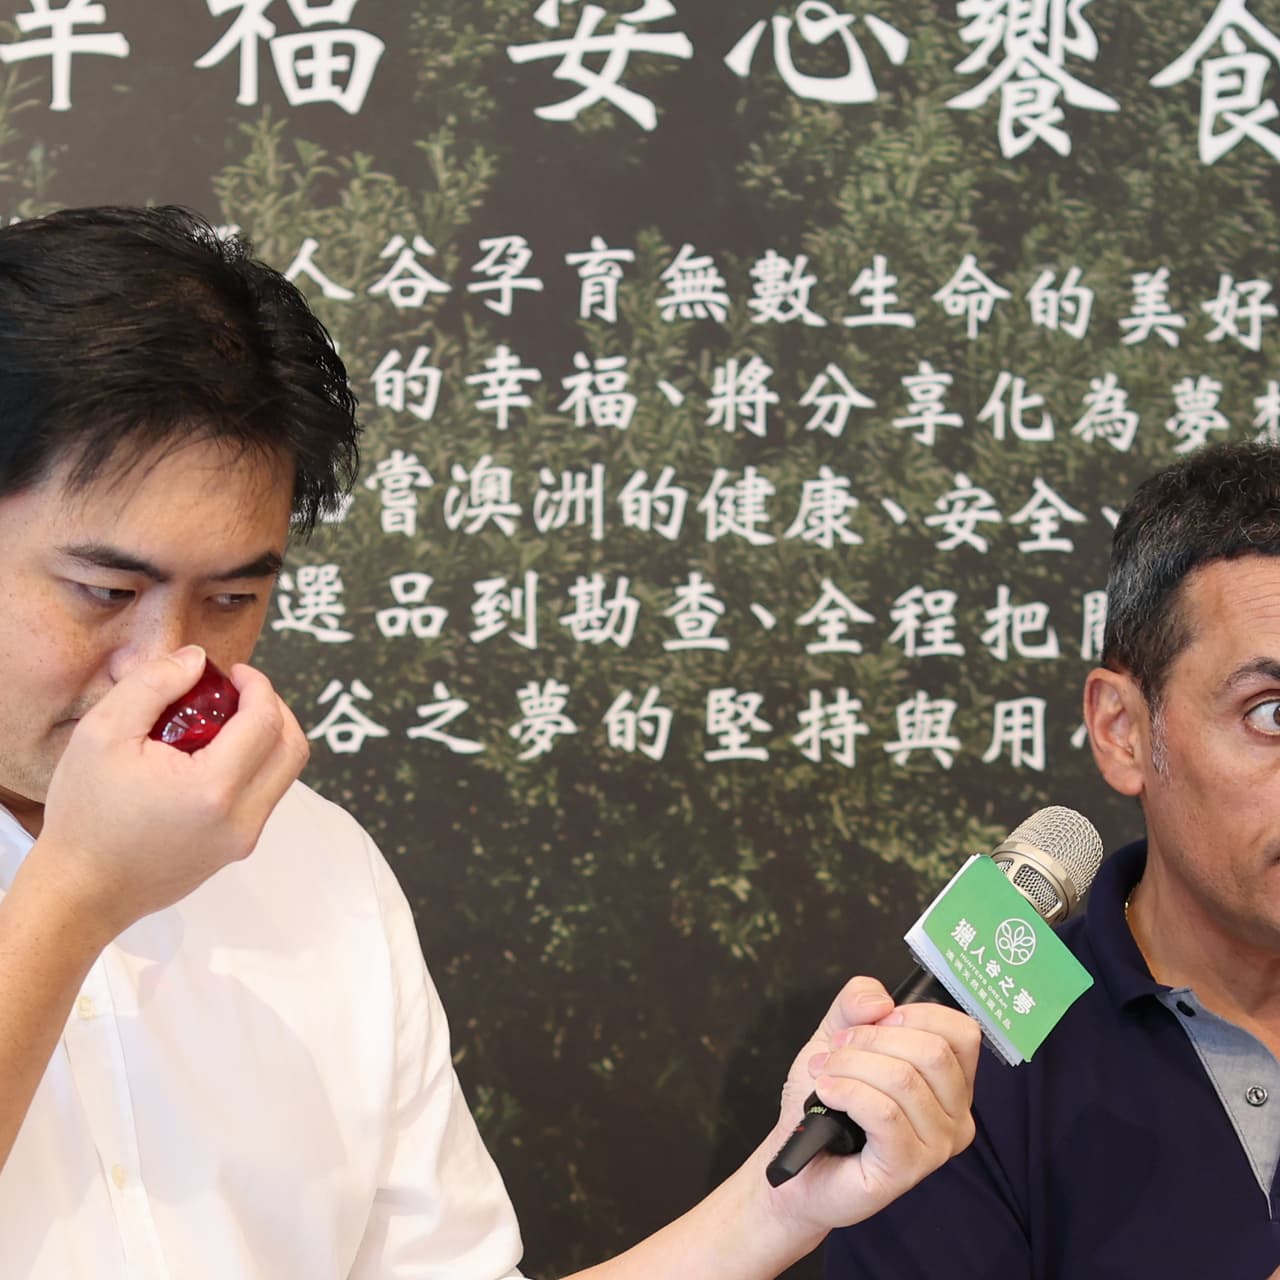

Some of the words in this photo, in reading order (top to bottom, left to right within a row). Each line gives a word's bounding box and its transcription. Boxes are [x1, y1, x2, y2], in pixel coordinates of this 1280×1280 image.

[216, 222, 1278, 352] 人谷孕育無數生命的美好
[307, 679, 1086, 771] 谷之夢的堅持與用
